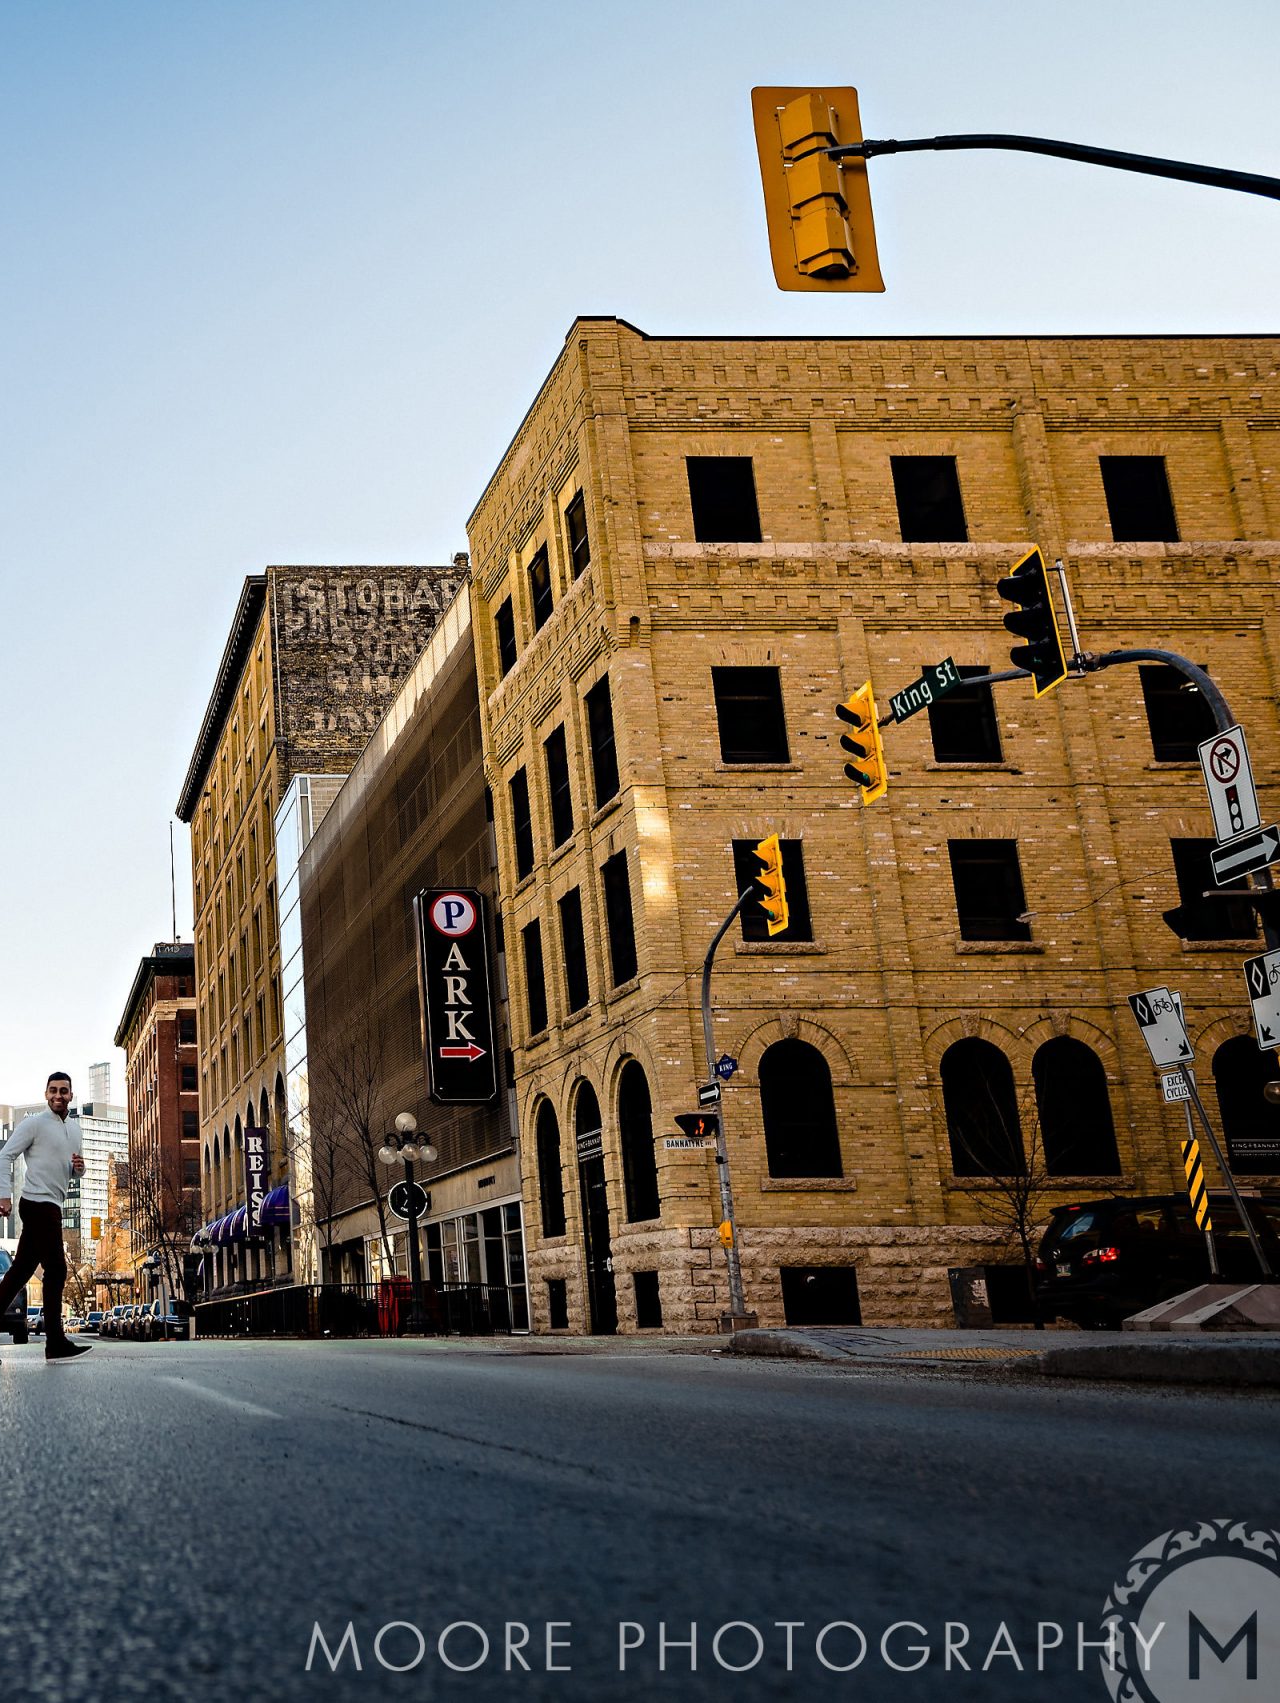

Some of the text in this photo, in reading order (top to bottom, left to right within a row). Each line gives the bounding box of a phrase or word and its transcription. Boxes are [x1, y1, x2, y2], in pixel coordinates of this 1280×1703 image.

[892, 661, 956, 717] King St
[719, 1062, 733, 1072] KING
[1167, 1074, 1185, 1087] EXCE
[1166, 1086, 1187, 1098] CYCLIS
[248, 1137, 264, 1227] REISS
